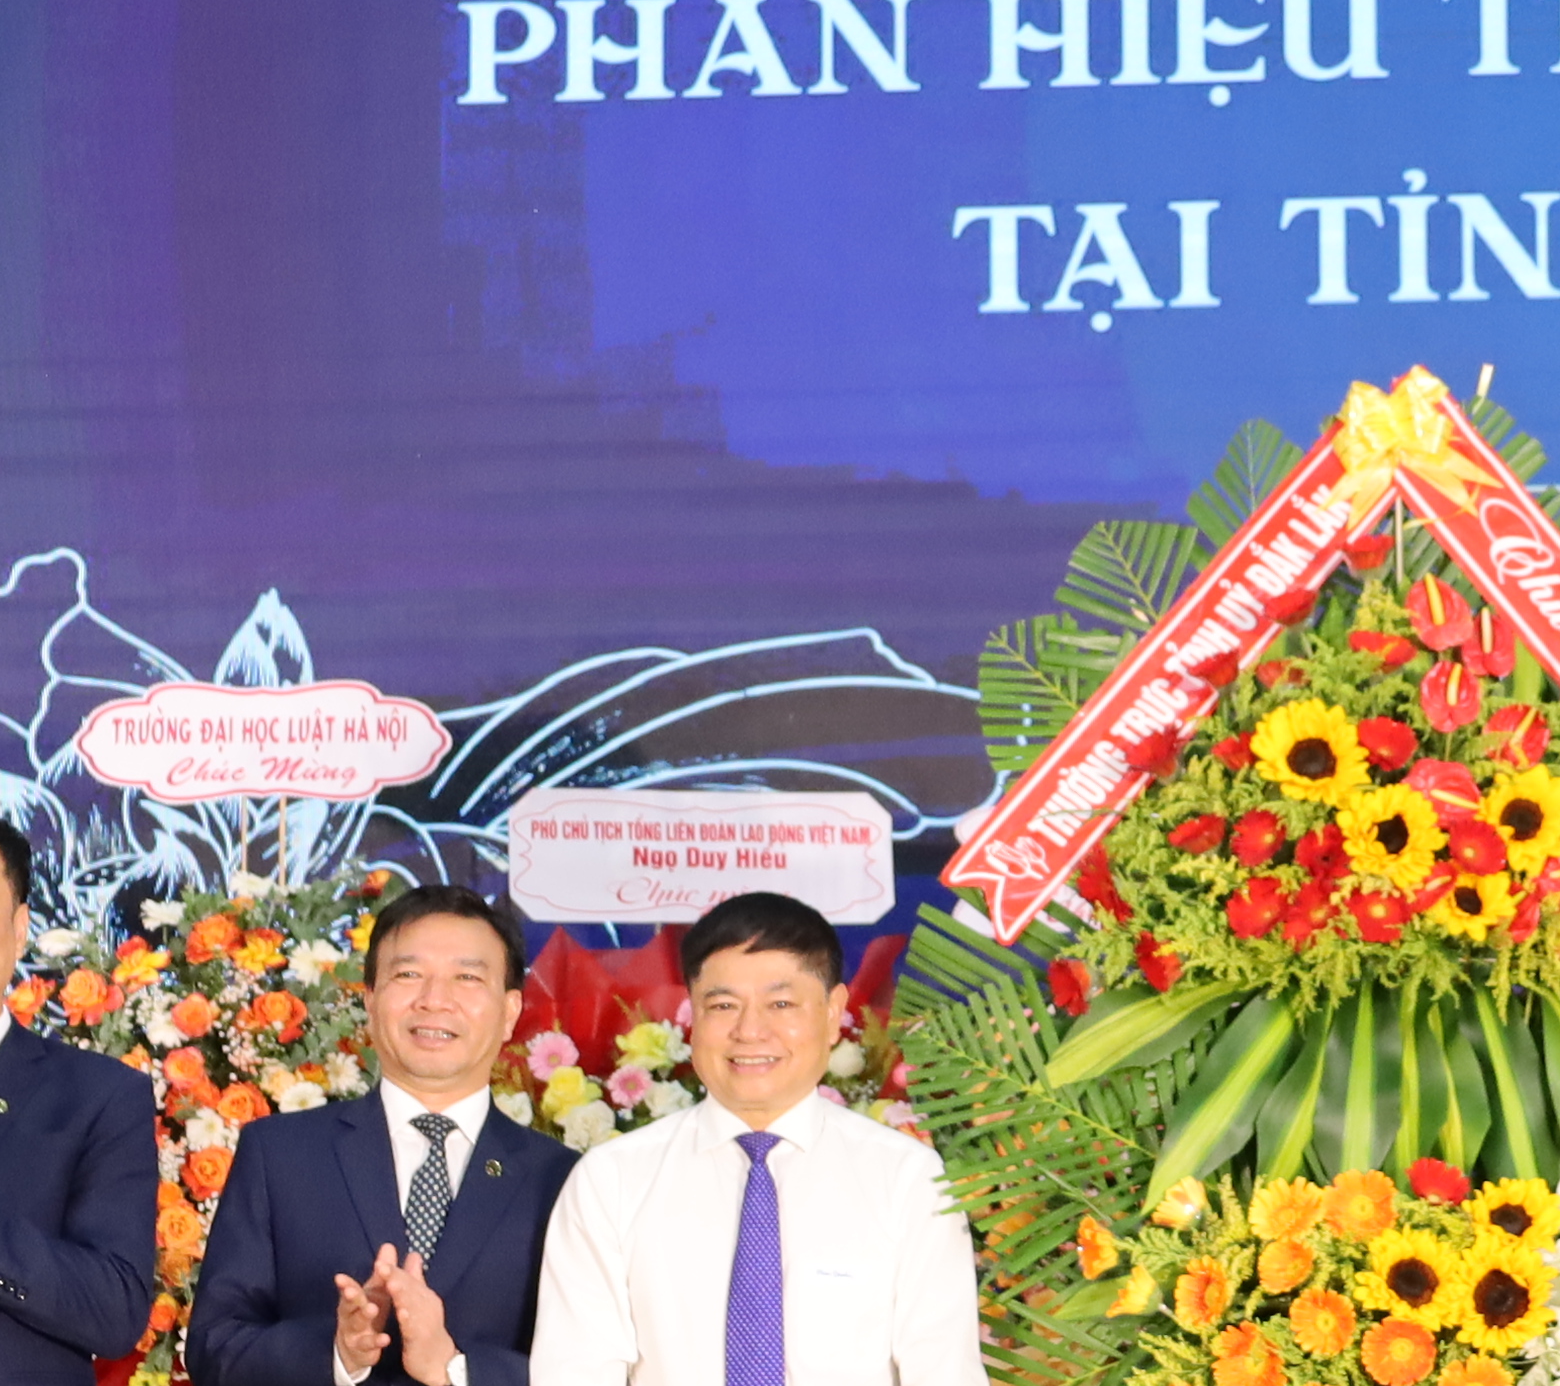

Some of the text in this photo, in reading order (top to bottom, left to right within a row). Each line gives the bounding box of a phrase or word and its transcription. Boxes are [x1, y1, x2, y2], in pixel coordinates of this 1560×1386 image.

[952, 196, 1222, 334] TẠI
[1027, 740, 1130, 848] THƯỜNG
[1244, 531, 1316, 597] ĐẮK
[111, 705, 409, 752] TRƯỜNG ĐẠI HỌC LUẬT HÀ NỘI
[165, 756, 359, 787] Chúc Mừng
[531, 816, 558, 839] PHÓ
[740, 822, 764, 843] LAO
[841, 825, 872, 846] NAM
[632, 846, 678, 873] Ngọ
[686, 847, 729, 871] Duy
